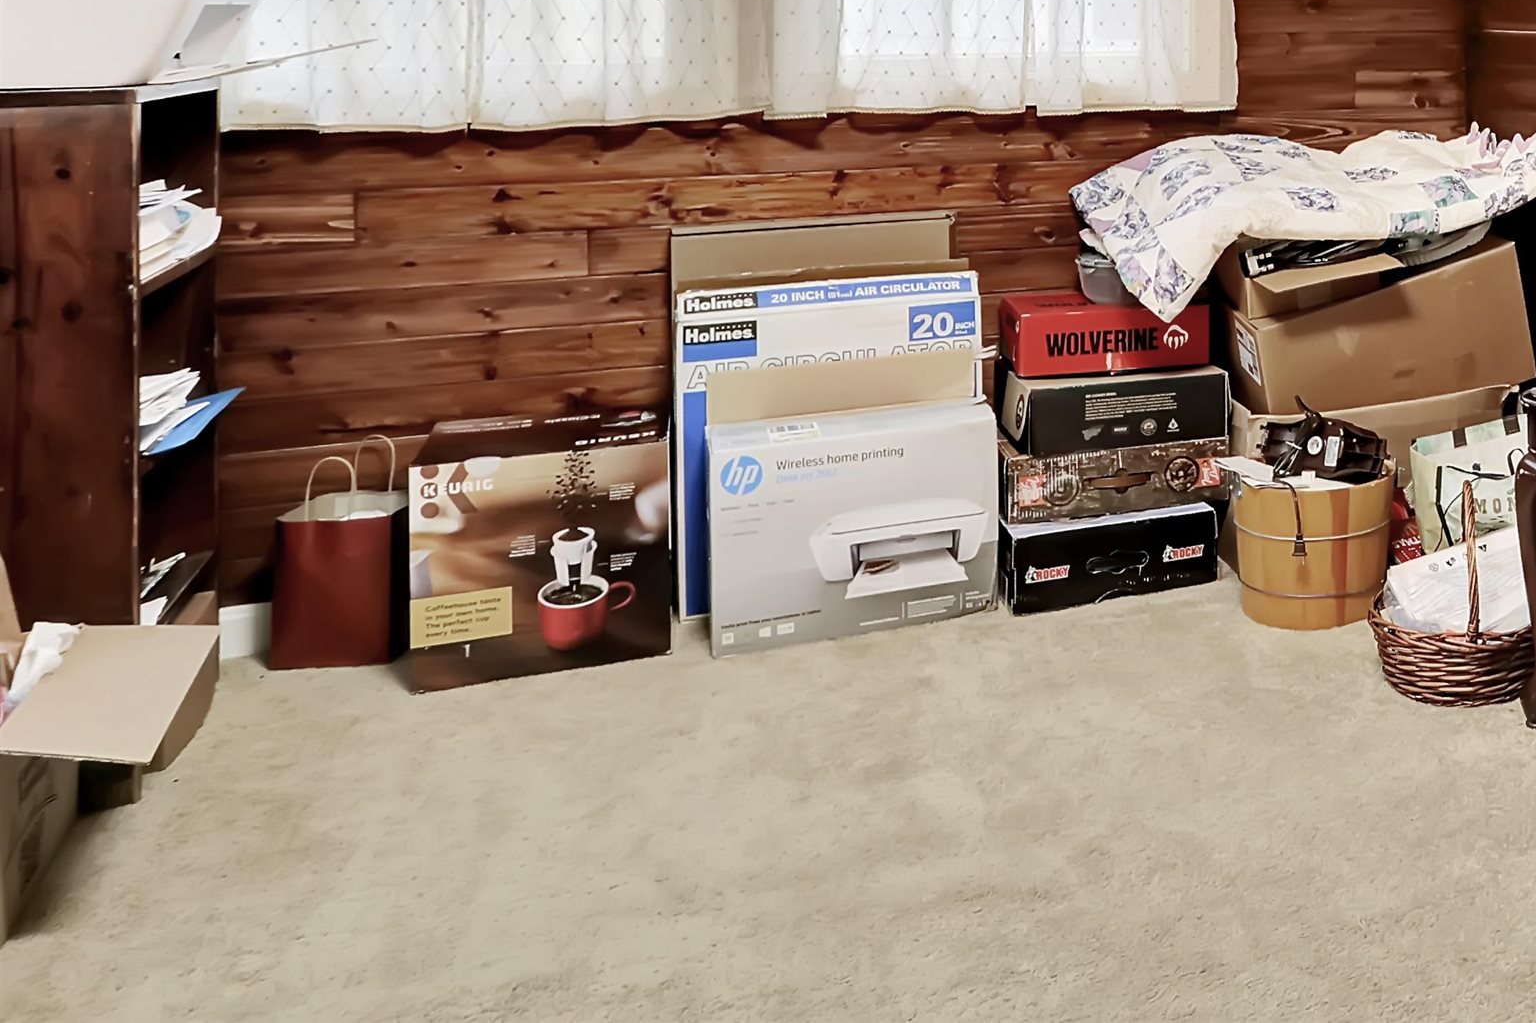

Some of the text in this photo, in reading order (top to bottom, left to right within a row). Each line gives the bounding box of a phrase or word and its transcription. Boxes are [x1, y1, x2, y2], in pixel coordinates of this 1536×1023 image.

[770, 293, 788, 304] 20
[791, 290, 824, 303] INCH
[855, 286, 878, 296] AIR
[880, 280, 960, 295] CIRCULATOR
[912, 311, 955, 339] 20
[954, 321, 975, 330] INCH
[685, 326, 754, 344] Holmes
[1046, 326, 1160, 357] WOLVERINE
[776, 446, 905, 471] Wireless home printing
[724, 456, 761, 495] hp
[423, 478, 494, 499] KEURIG
[1171, 544, 1204, 560] ROCKY
[1035, 564, 1070, 580] ROCKY
[425, 600, 477, 613] Coffeehouse
[435, 612, 453, 621] your
[442, 617, 473, 628] perfect
[425, 630, 448, 639] every
